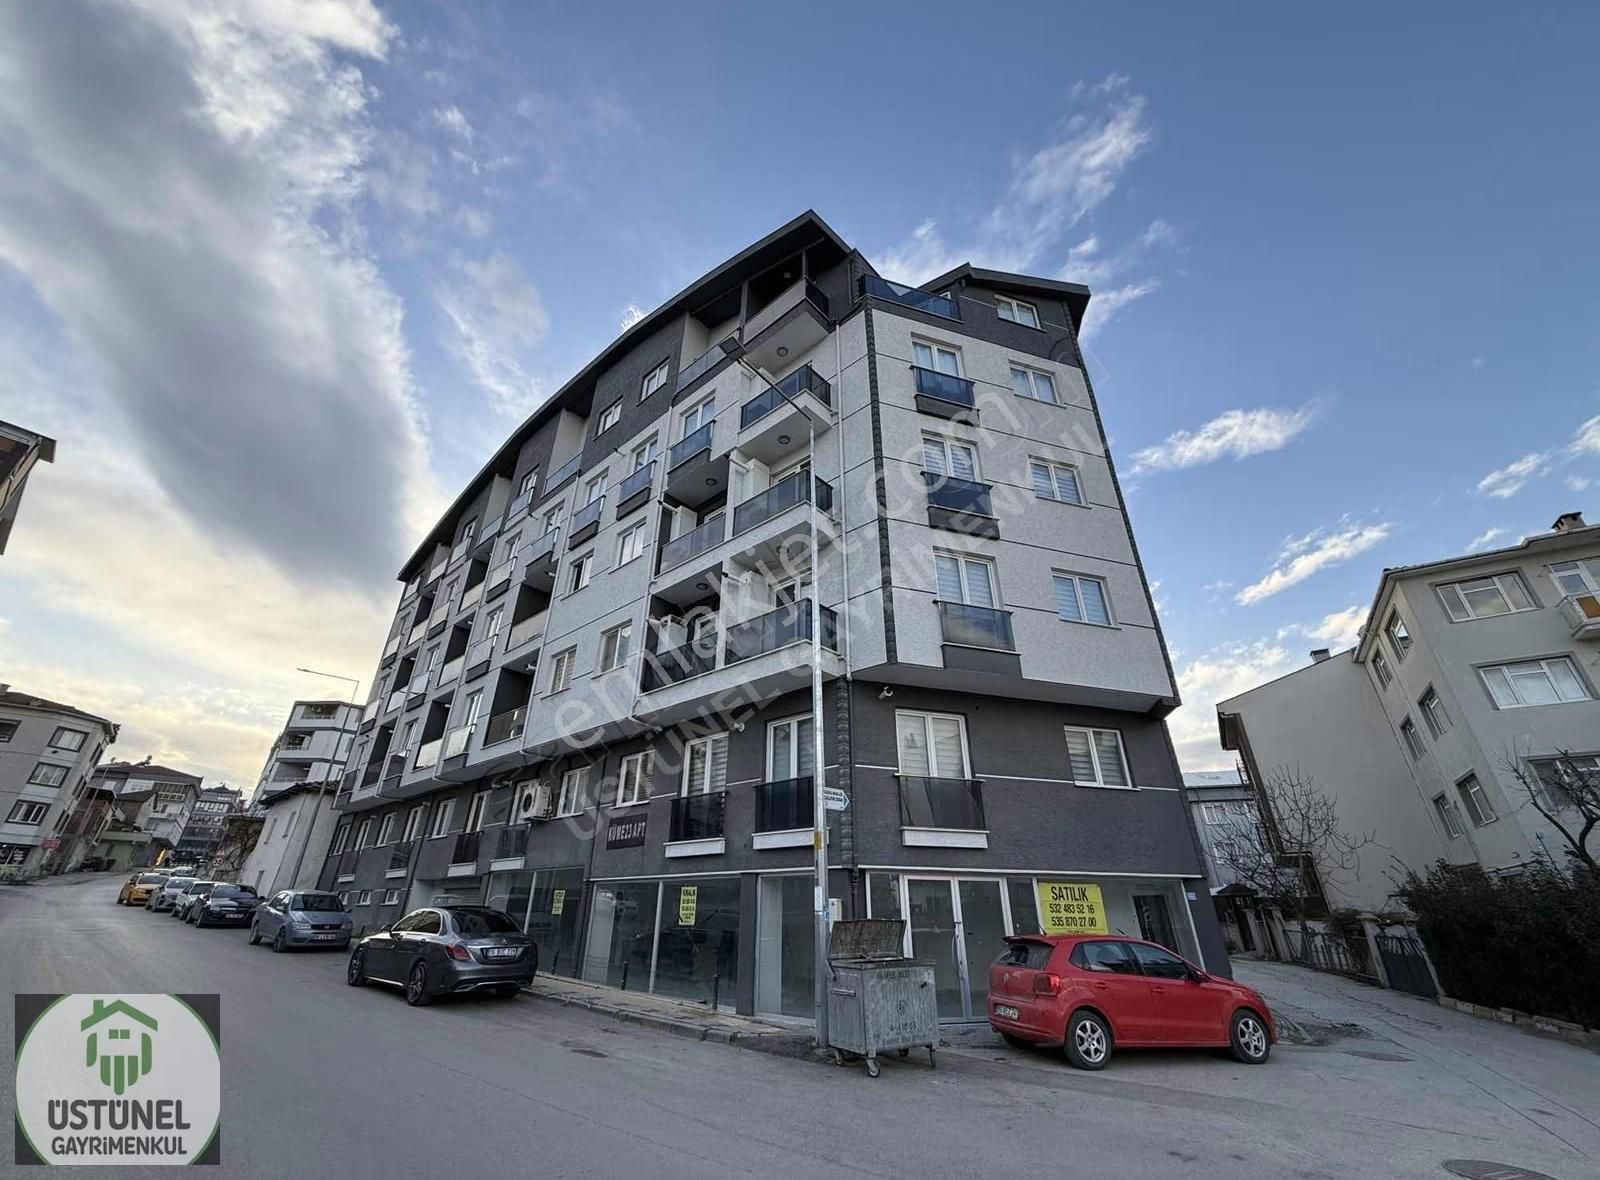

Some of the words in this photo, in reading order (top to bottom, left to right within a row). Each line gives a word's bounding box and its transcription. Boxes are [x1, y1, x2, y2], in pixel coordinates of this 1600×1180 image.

[1051, 886, 1088, 901] SATILIK
[1049, 904, 1062, 914] 532
[1076, 904, 1085, 914] 52
[1087, 904, 1095, 914] 16
[1051, 917, 1064, 927] 535
[1065, 917, 1077, 927] 870
[1088, 917, 1096, 927] 00
